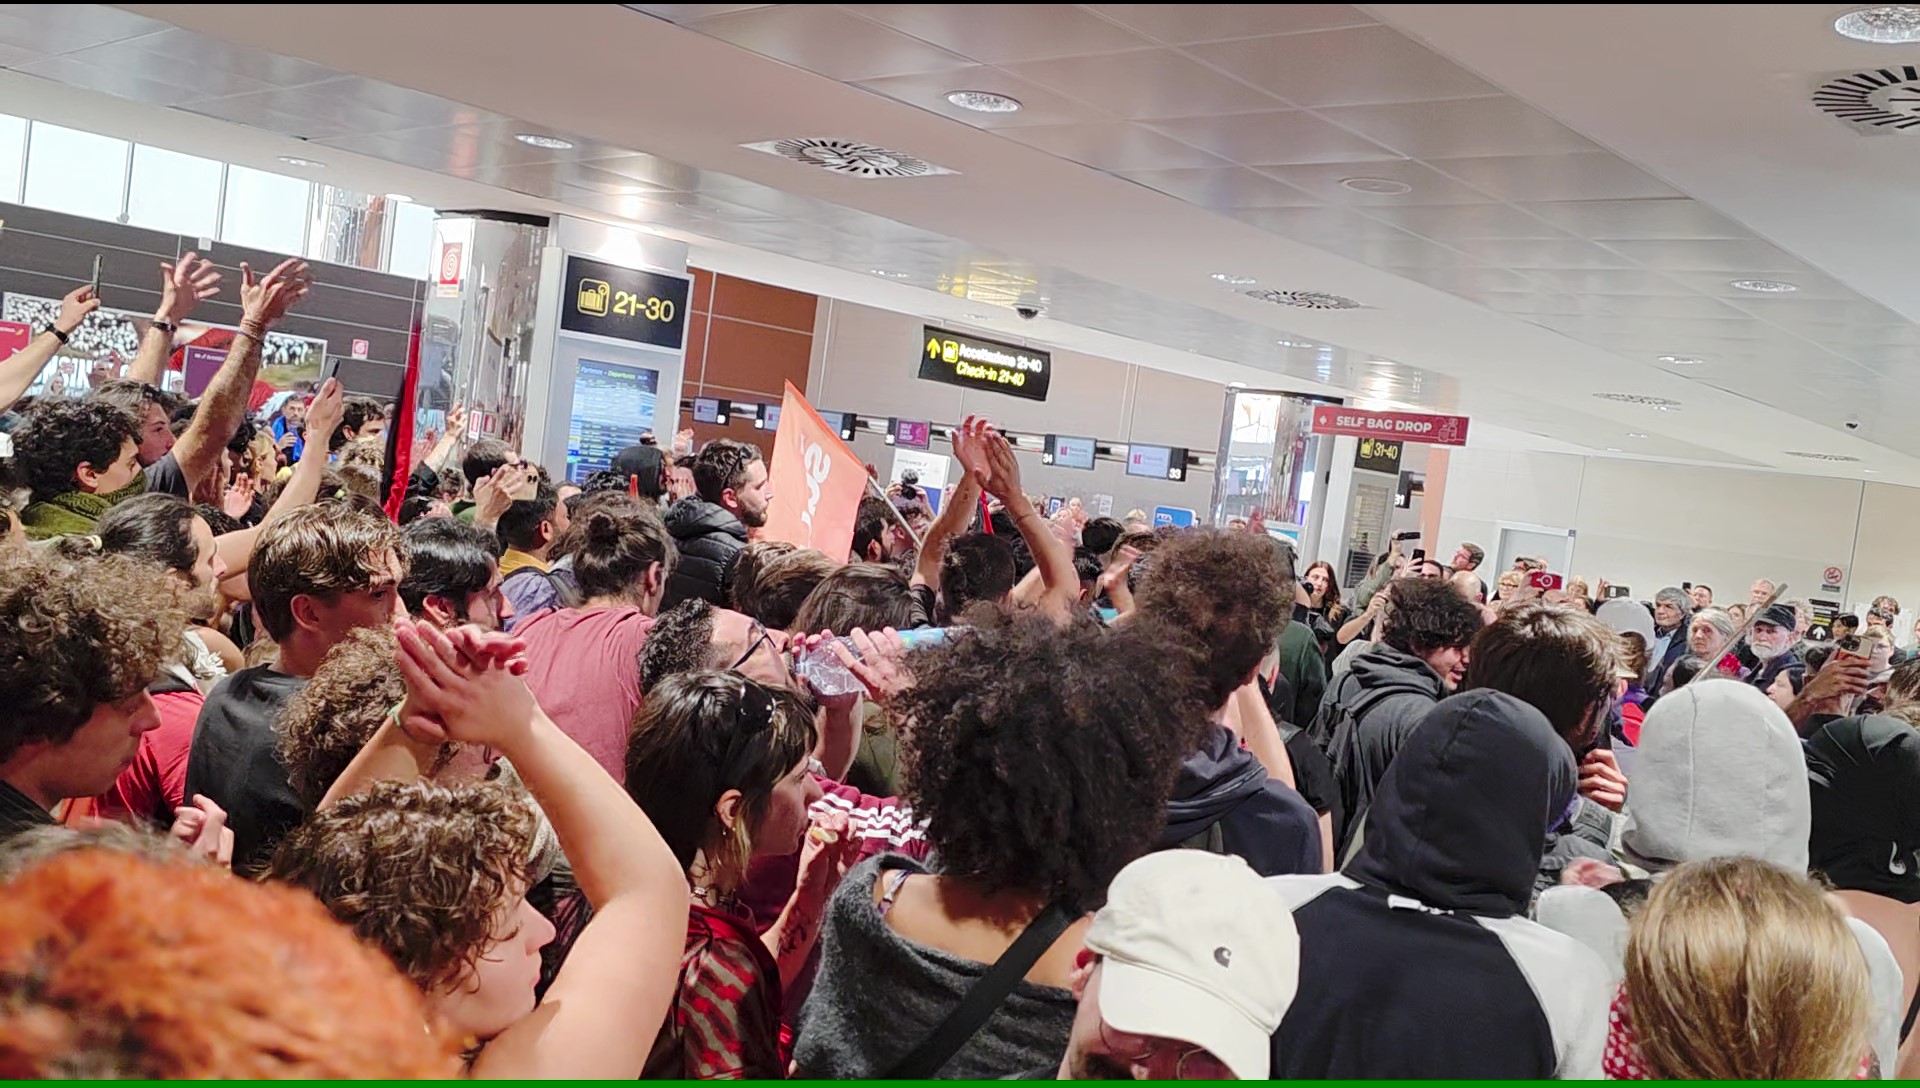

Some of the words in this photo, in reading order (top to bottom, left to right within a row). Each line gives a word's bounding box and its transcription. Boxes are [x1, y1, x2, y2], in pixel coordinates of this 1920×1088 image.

[613, 290, 675, 323] 21-30
[1017, 355, 1042, 373] 21-40
[956, 361, 998, 381] Check-in
[998, 369, 1025, 387] 21-40
[1336, 415, 1366, 427] SELF
[1367, 418, 1393, 430] BAG
[1395, 420, 1432, 433] DROP
[1043, 453, 1053, 463] 34
[1374, 442, 1398, 459] 31-40
[1169, 468, 1181, 479] 33
[1394, 494, 1405, 506] 31
